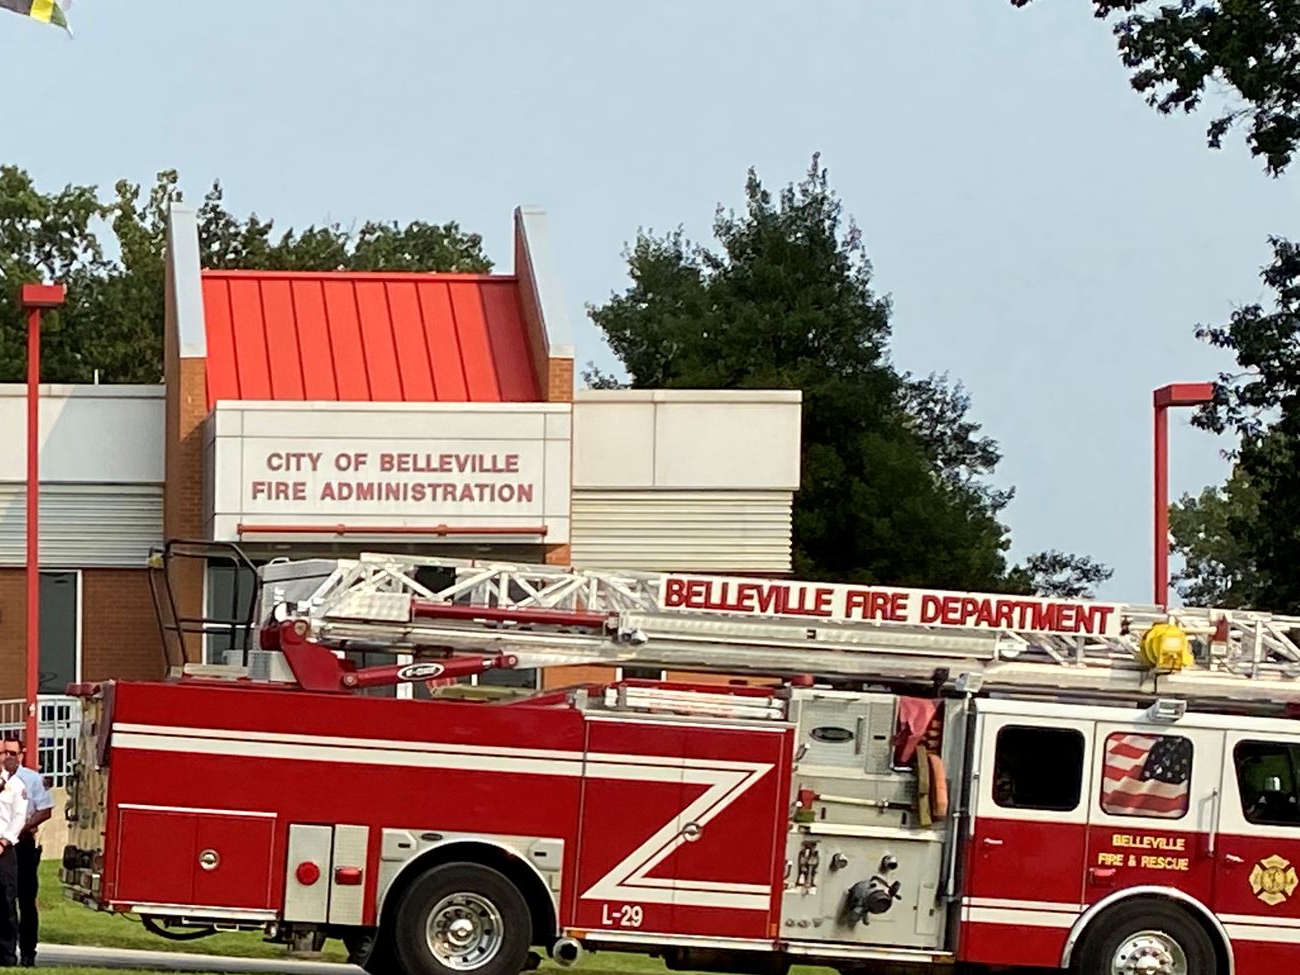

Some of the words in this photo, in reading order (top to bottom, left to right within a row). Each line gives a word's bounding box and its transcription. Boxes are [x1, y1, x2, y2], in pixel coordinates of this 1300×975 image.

[266, 452, 323, 472] CITY
[334, 453, 368, 472] OF
[379, 453, 519, 473] BELLEVILLE
[252, 481, 307, 501] FIRE
[320, 482, 533, 502] ADMINISTRATION
[664, 578, 835, 617] BELLEVILLE
[845, 589, 909, 622] FIRE
[920, 595, 1114, 635] DEPARTMENT
[1112, 834, 1185, 851] BELLEVILLE
[1098, 852, 1124, 866] FIRE
[1127, 854, 1137, 867] &
[1140, 855, 1189, 871] RESCUE
[602, 903, 643, 928] L-29
